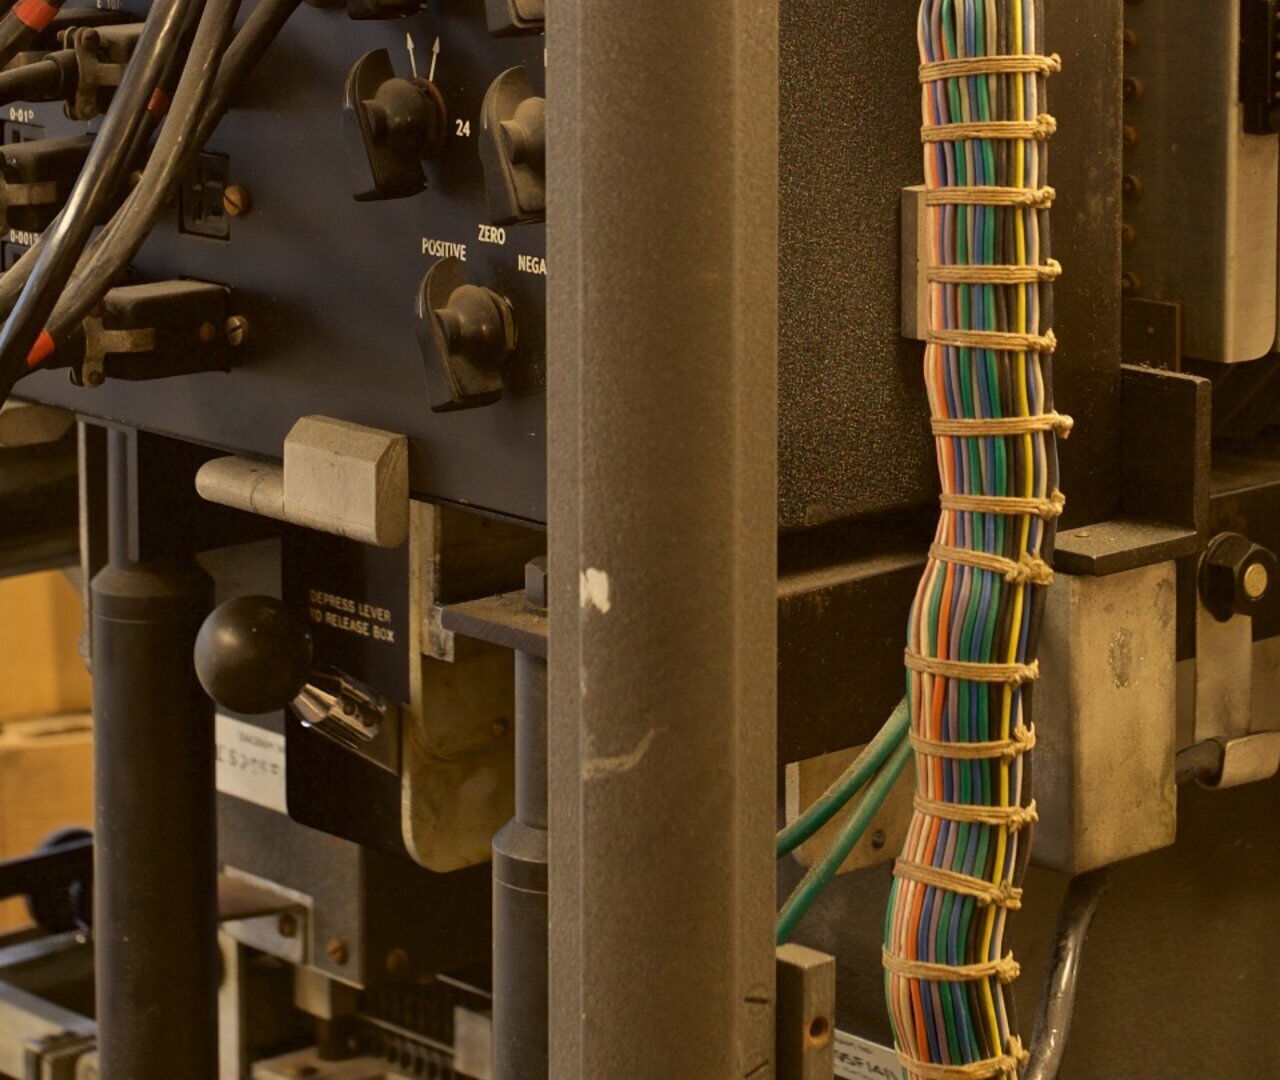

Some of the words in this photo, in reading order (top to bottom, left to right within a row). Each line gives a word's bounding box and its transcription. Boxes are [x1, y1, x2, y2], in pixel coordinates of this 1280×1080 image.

[455, 119, 470, 137] 24
[478, 224, 506, 245] ZERO
[422, 238, 466, 261] POSITIVE
[518, 254, 547, 275] NEGA
[309, 589, 356, 613] DEPRESS
[358, 603, 391, 623] LEVER
[324, 611, 370, 636] RELEASE
[372, 625, 395, 643] BOX
